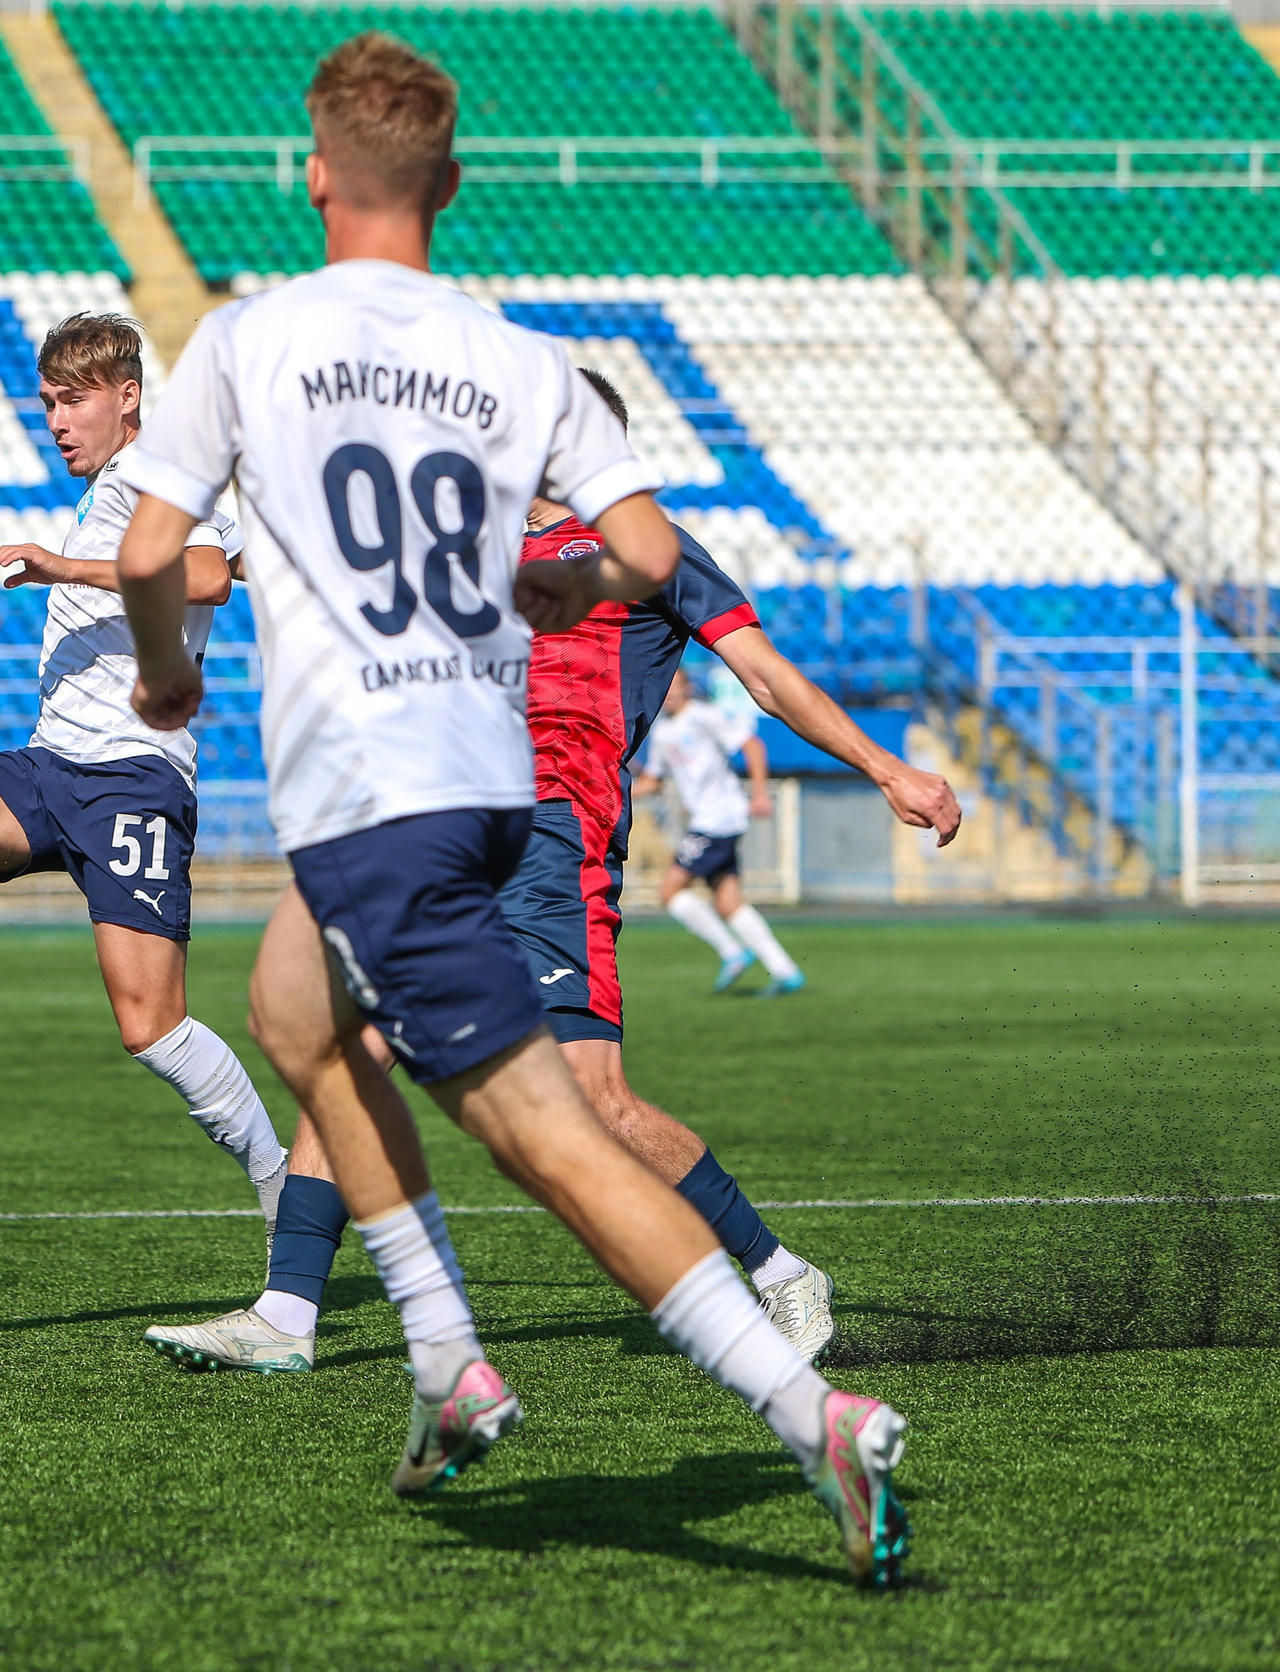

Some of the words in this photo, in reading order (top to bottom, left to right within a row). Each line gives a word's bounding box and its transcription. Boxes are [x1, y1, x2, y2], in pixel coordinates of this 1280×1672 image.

[300, 359, 498, 430] МАКСИМОВ
[322, 443, 502, 638] 98
[107, 812, 171, 881] 51
